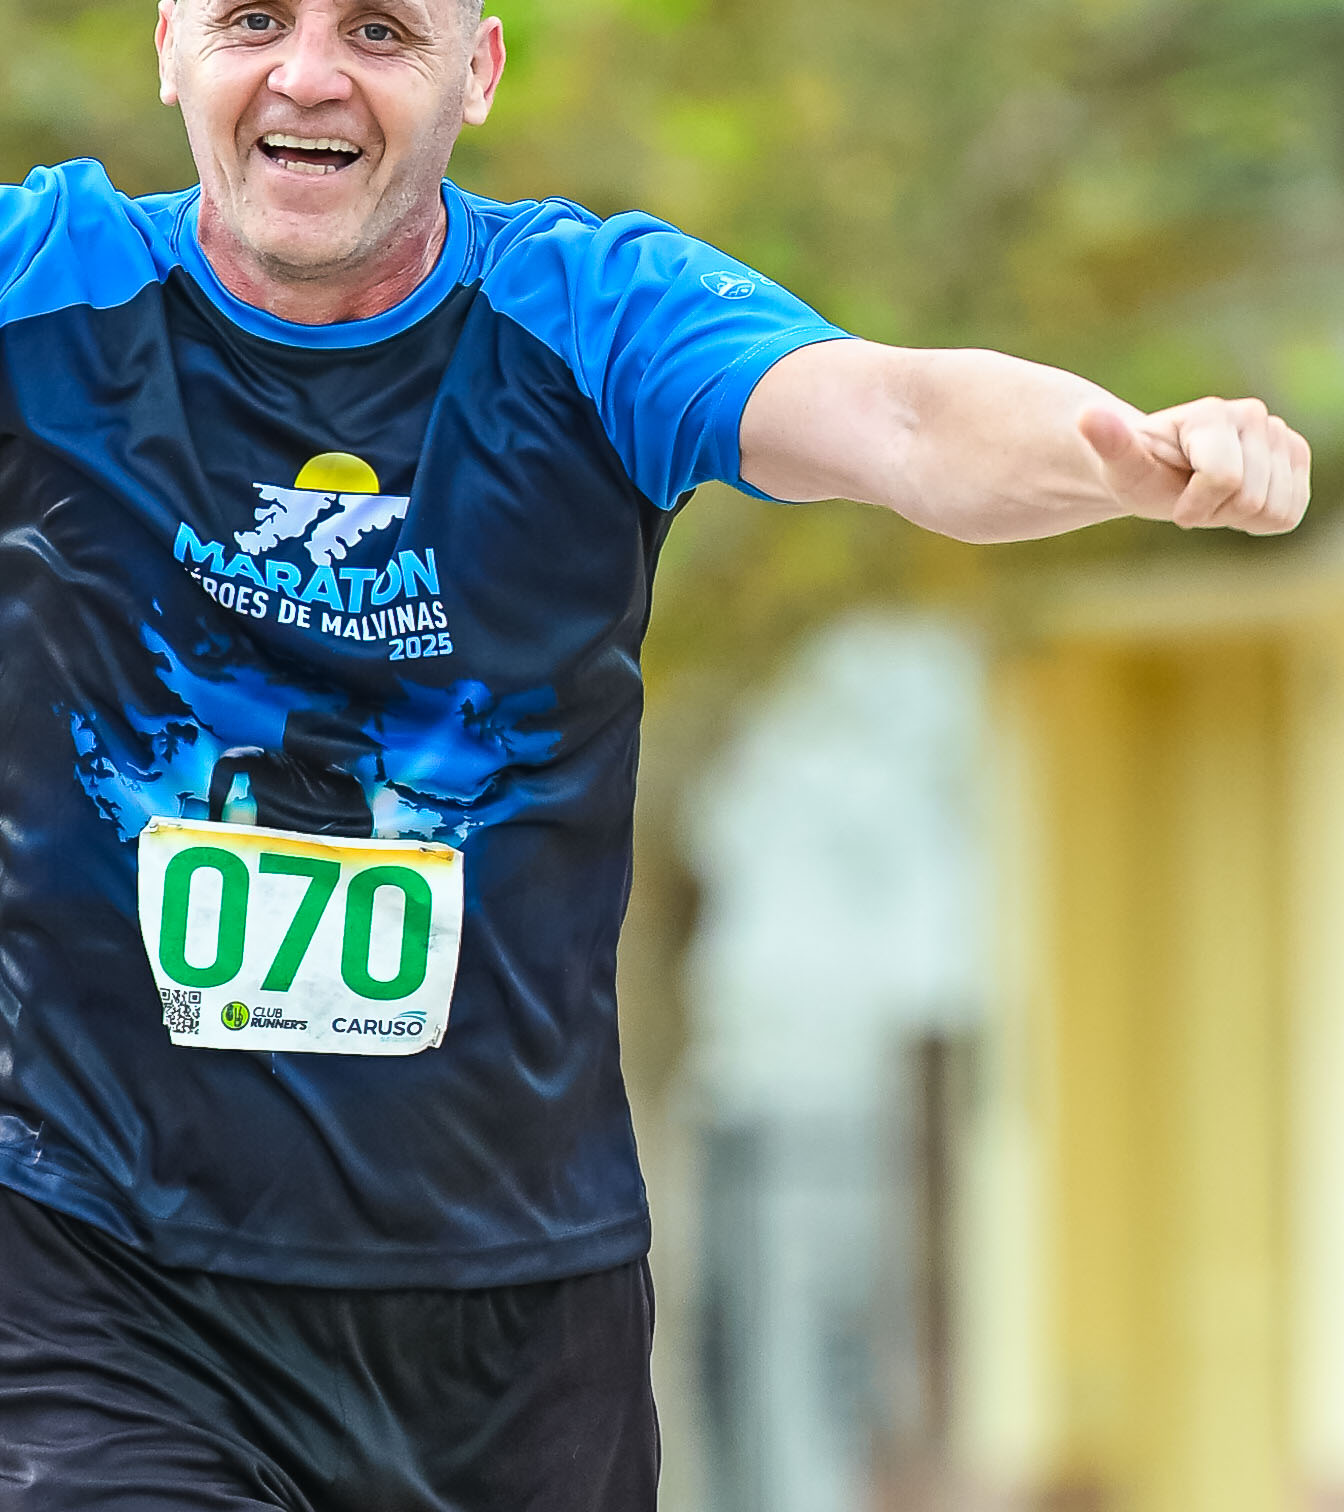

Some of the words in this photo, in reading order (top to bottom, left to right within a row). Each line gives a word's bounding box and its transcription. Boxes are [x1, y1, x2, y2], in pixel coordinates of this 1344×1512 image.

[184, 567, 270, 619] ROES
[277, 599, 311, 628] DE
[321, 600, 448, 641] MALVINAS
[389, 633, 454, 661] 2025
[159, 846, 433, 1001] 070
[252, 1006, 283, 1018] CLUB
[331, 1017, 424, 1036] CARUSO
